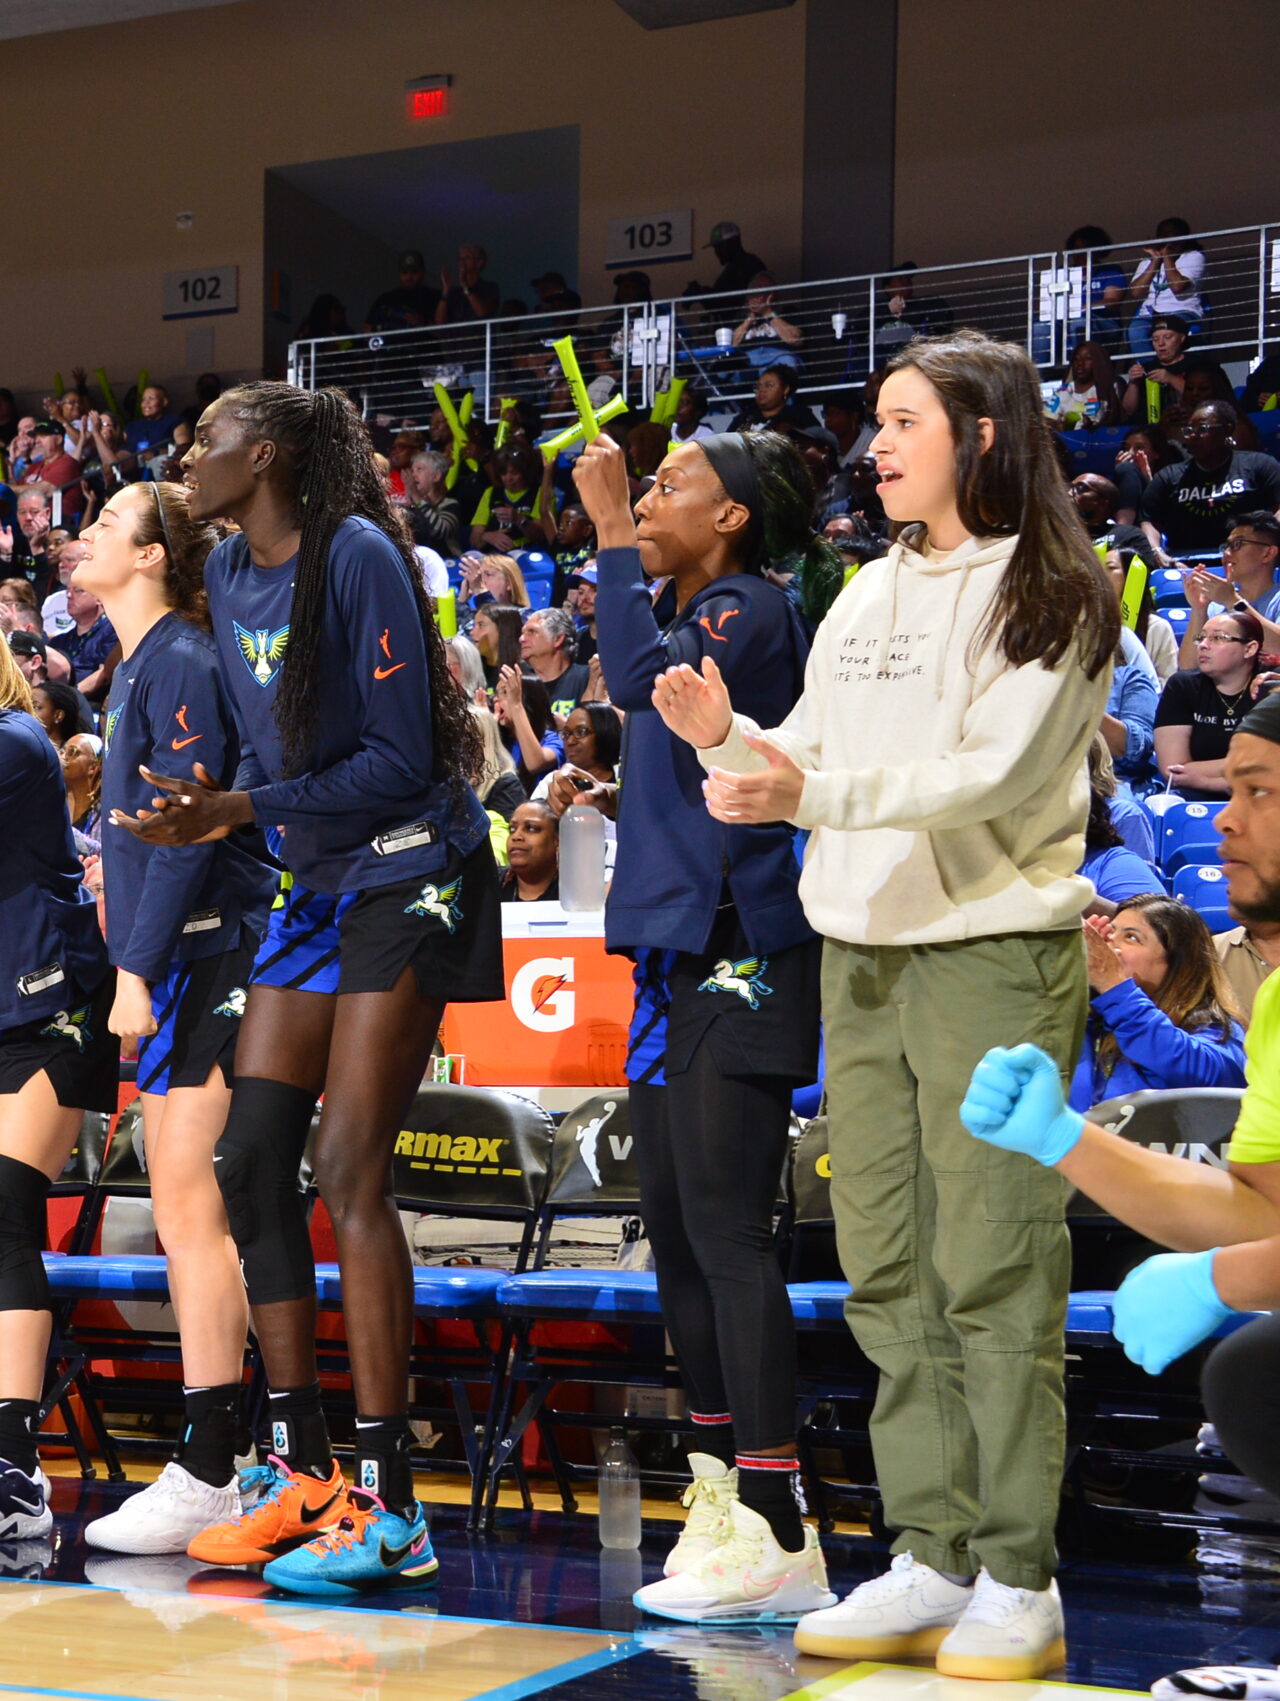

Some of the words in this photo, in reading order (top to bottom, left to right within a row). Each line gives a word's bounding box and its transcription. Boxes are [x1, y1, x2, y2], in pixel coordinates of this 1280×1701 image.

[414, 90, 444, 117] EXIT
[624, 221, 673, 251] 103
[178, 276, 222, 303] 102
[1178, 478, 1245, 503] DALLAS
[843, 637, 857, 648] IF
[865, 638, 878, 648] IT
[839, 654, 870, 665] YOUR
[1223, 718, 1238, 726] BY
[510, 956, 577, 1032] G
